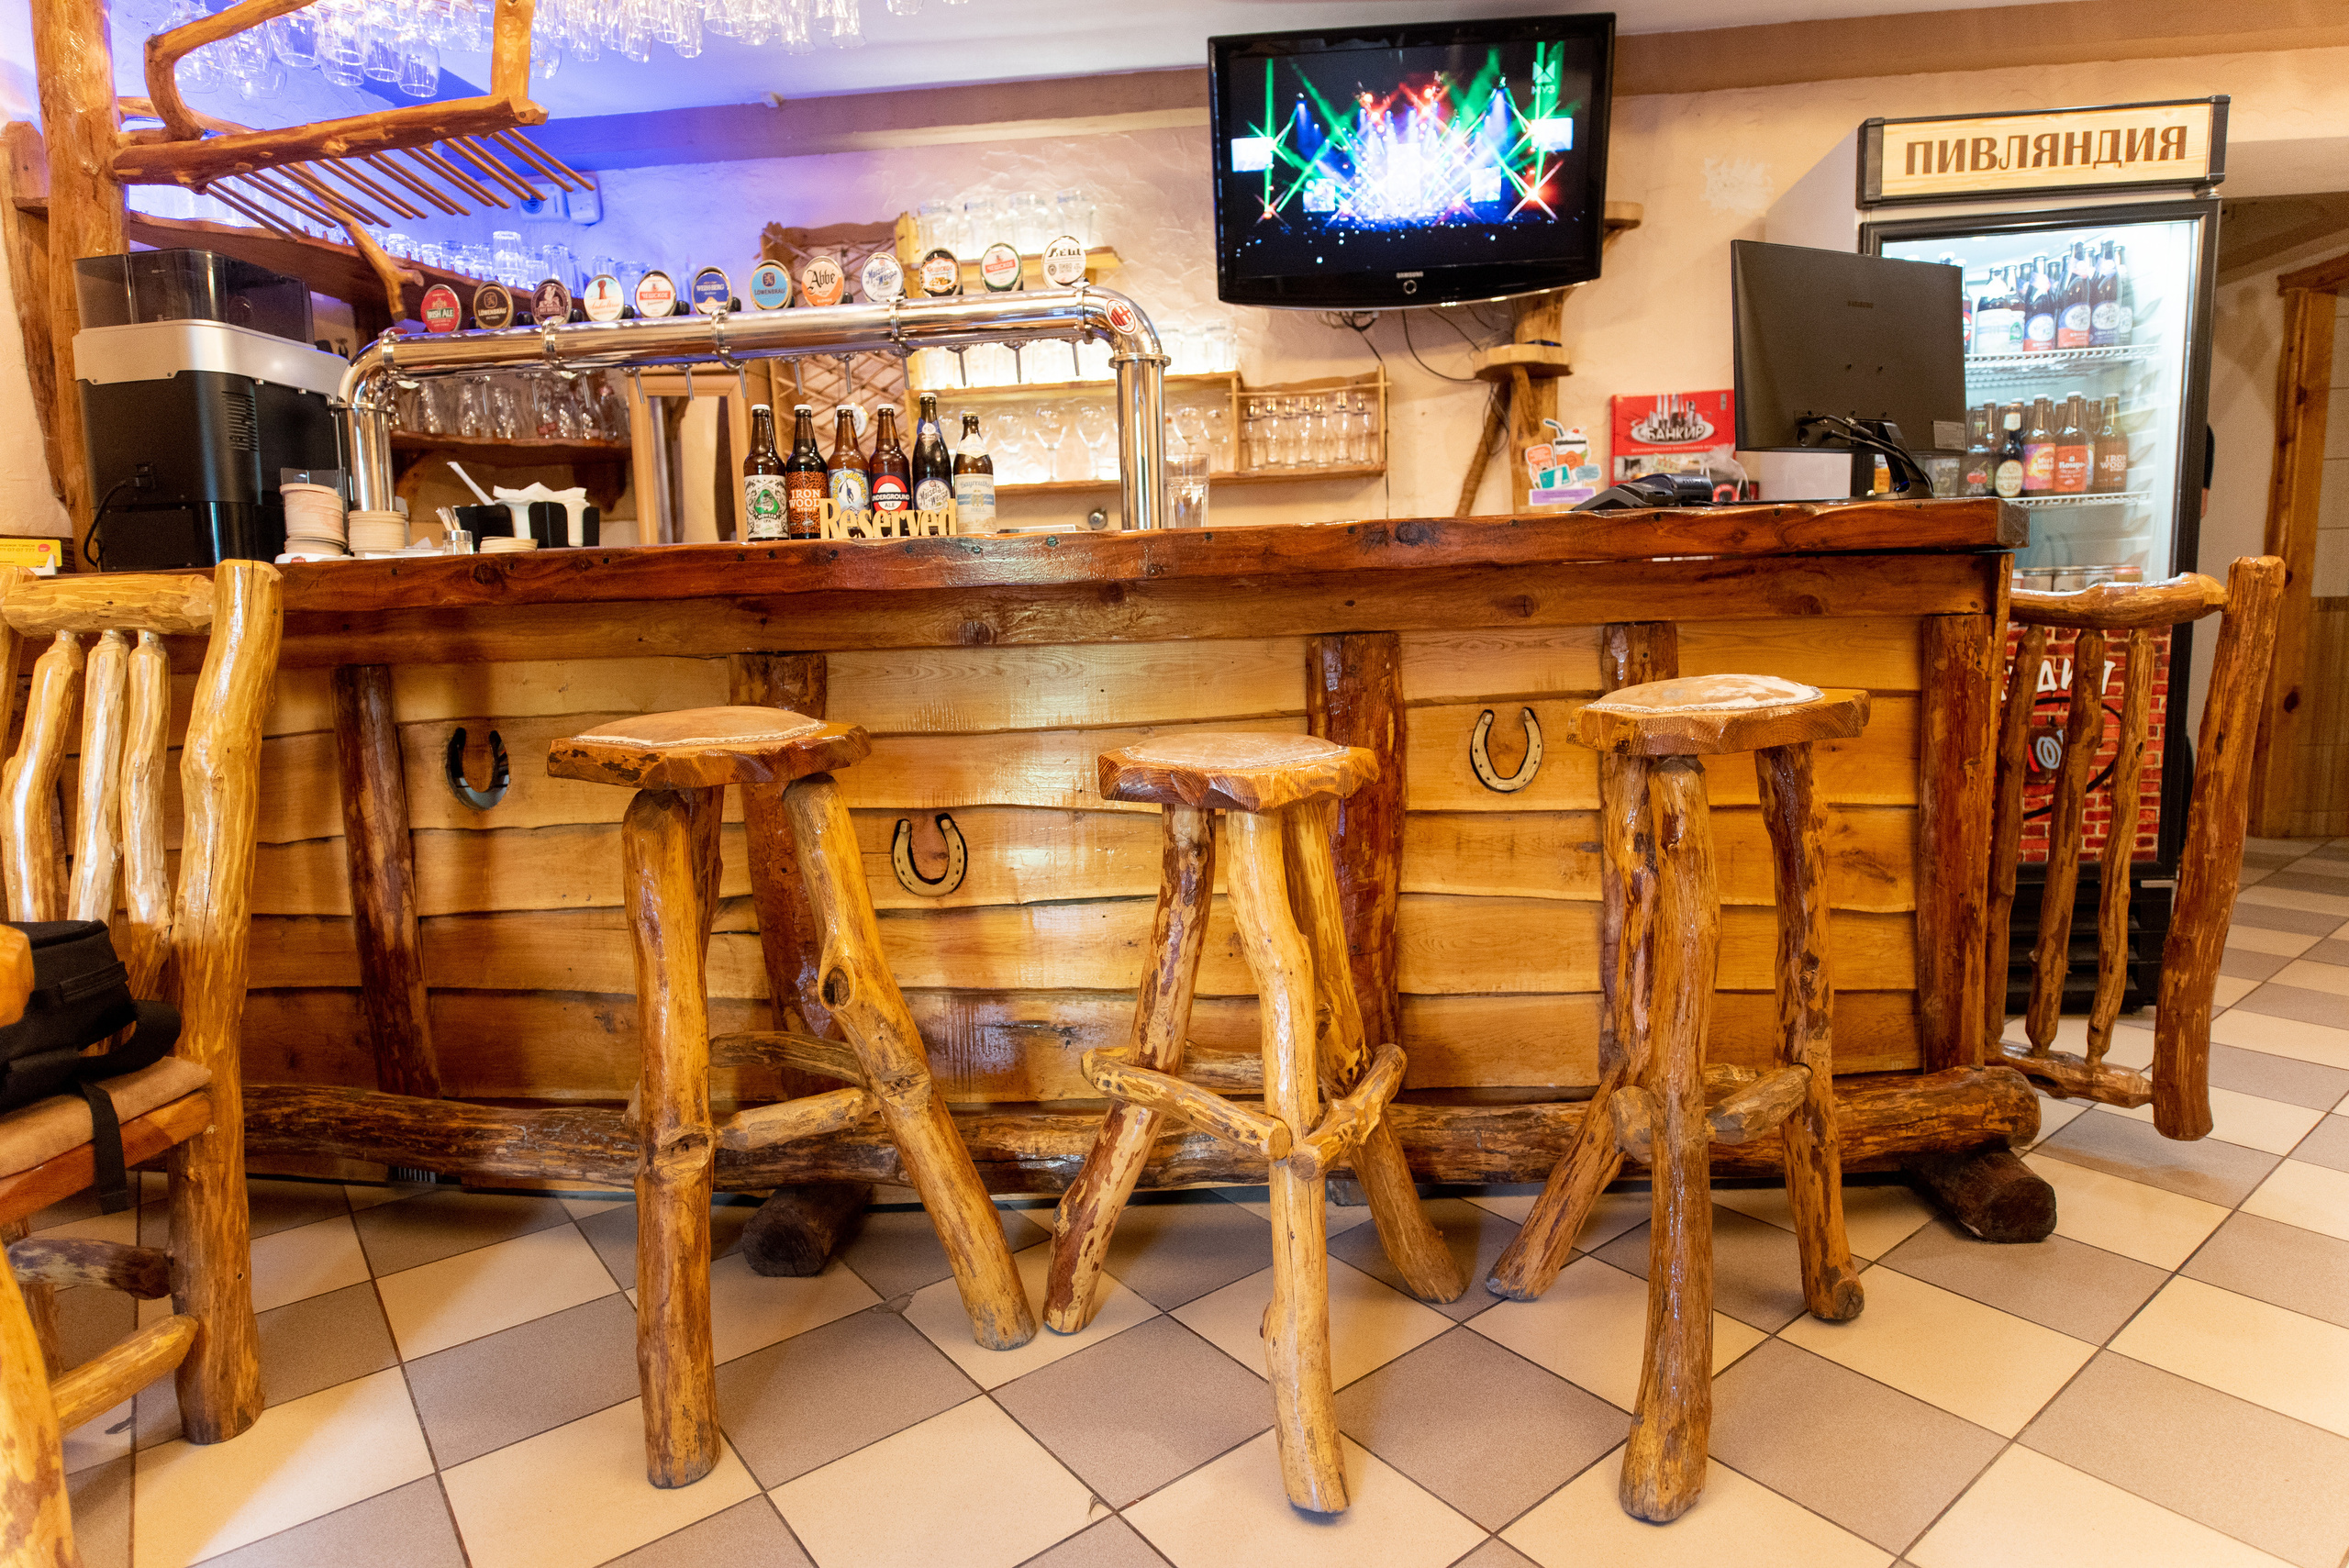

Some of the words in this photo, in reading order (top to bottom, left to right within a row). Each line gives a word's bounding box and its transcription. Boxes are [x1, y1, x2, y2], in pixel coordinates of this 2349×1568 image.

[1905, 125, 2188, 176] ПИВЛЯНДИЯ
[807, 269, 836, 295] Abbé
[640, 291, 669, 299] ЧЕШСКОЕ
[427, 309, 441, 319] IRISH
[442, 308, 454, 318] ALE
[1647, 424, 1704, 440] БАНКИР
[791, 489, 821, 499] IRON
[842, 471, 867, 503] MONKEY
[819, 497, 957, 539] Reserved
